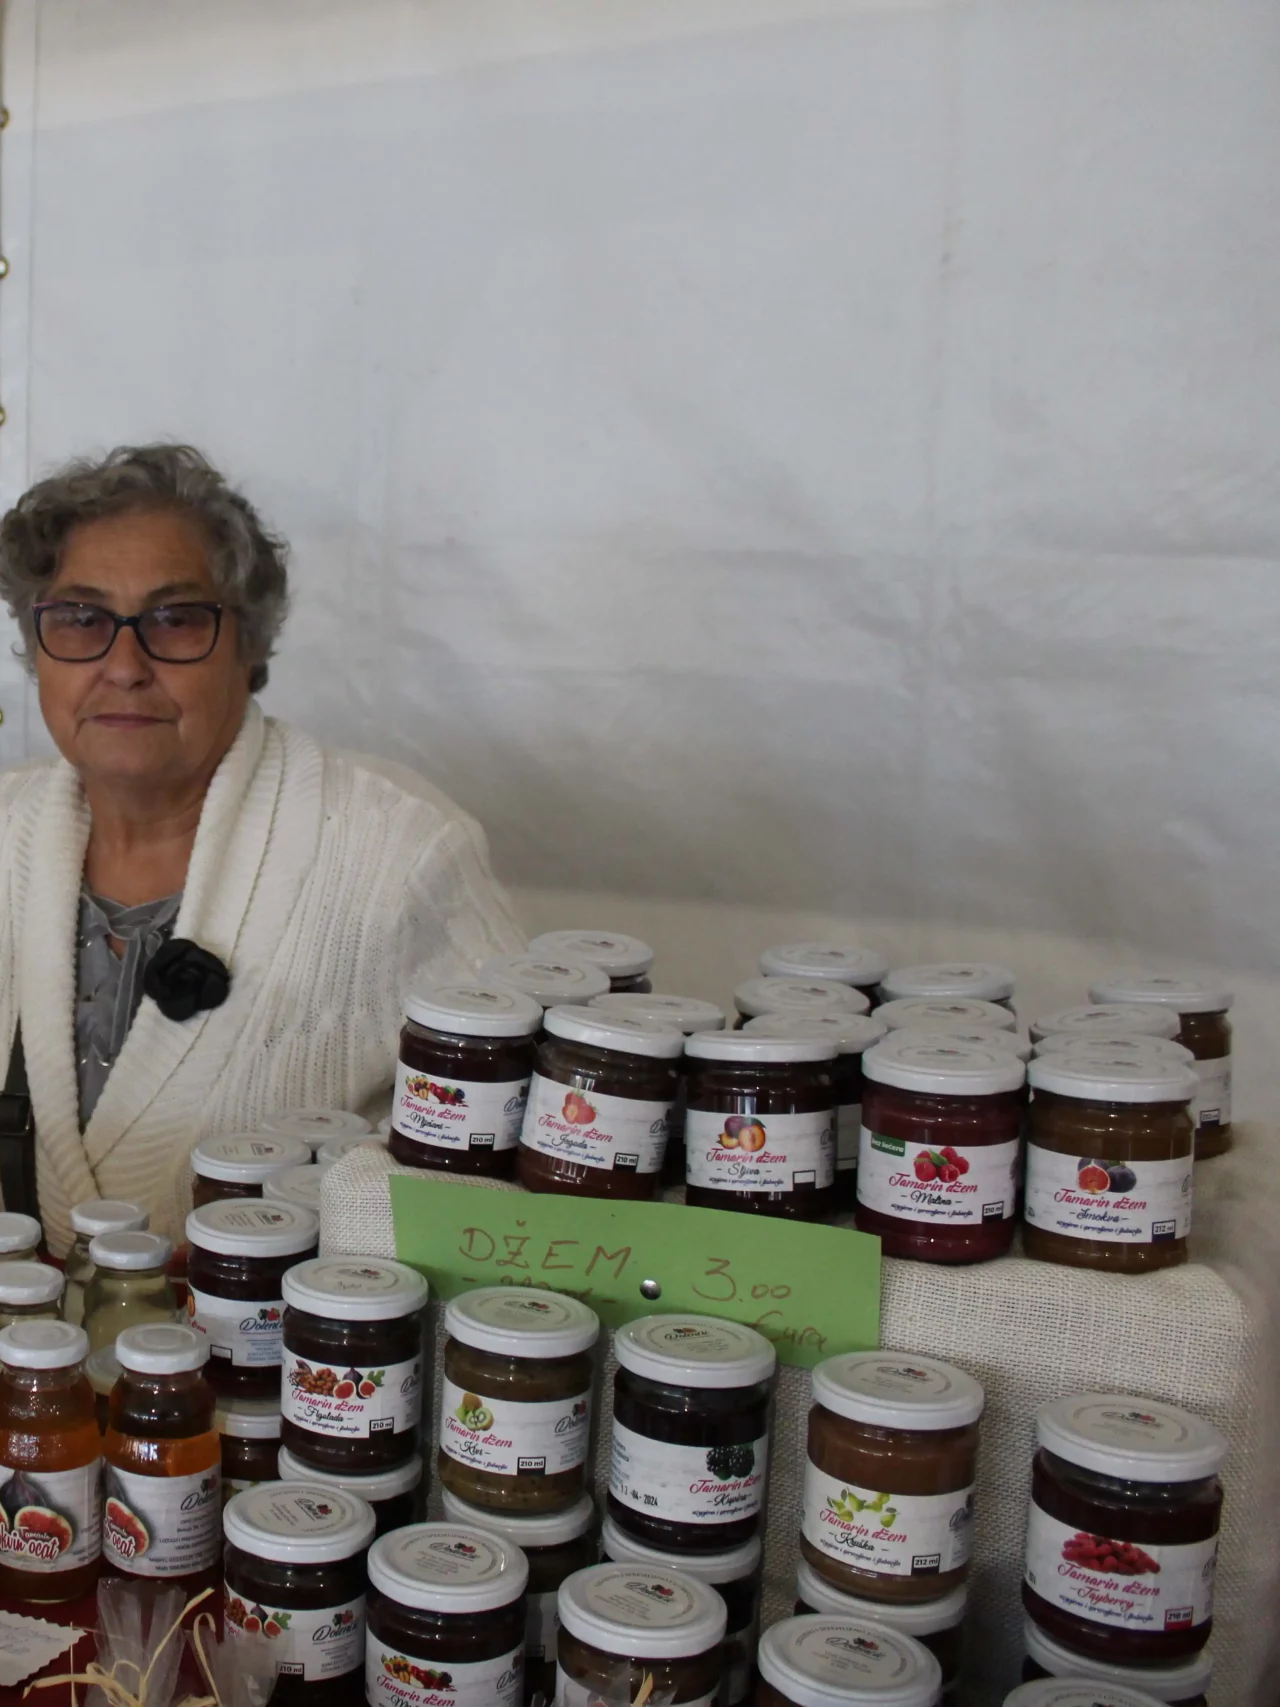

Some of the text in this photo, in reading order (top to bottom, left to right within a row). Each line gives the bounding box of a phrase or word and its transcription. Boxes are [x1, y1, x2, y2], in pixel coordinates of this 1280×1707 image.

[400, 1095, 436, 1117] Tamarin
[538, 1113, 581, 1136] Tamarin
[706, 1148, 753, 1163] Tamarin
[889, 1172, 943, 1192] Tamarin
[910, 1190, 952, 1206] Malina
[1053, 1188, 1110, 1209] Tamarin
[458, 1220, 632, 1280] DŽEM
[692, 1257, 792, 1302] 3.00
[291, 1387, 332, 1409] Tamarin
[372, 1421, 384, 1430] 210
[445, 1416, 480, 1442] Tamarin
[689, 1479, 741, 1494] Tamarin
[820, 1508, 869, 1536] Tamarin
[29, 1538, 60, 1559] ocat
[928, 1557, 939, 1565] ml
[1058, 1562, 1119, 1591] Tamarin
[1077, 1585, 1135, 1612] Tayberry
[376, 1674, 420, 1701] Tamarin
